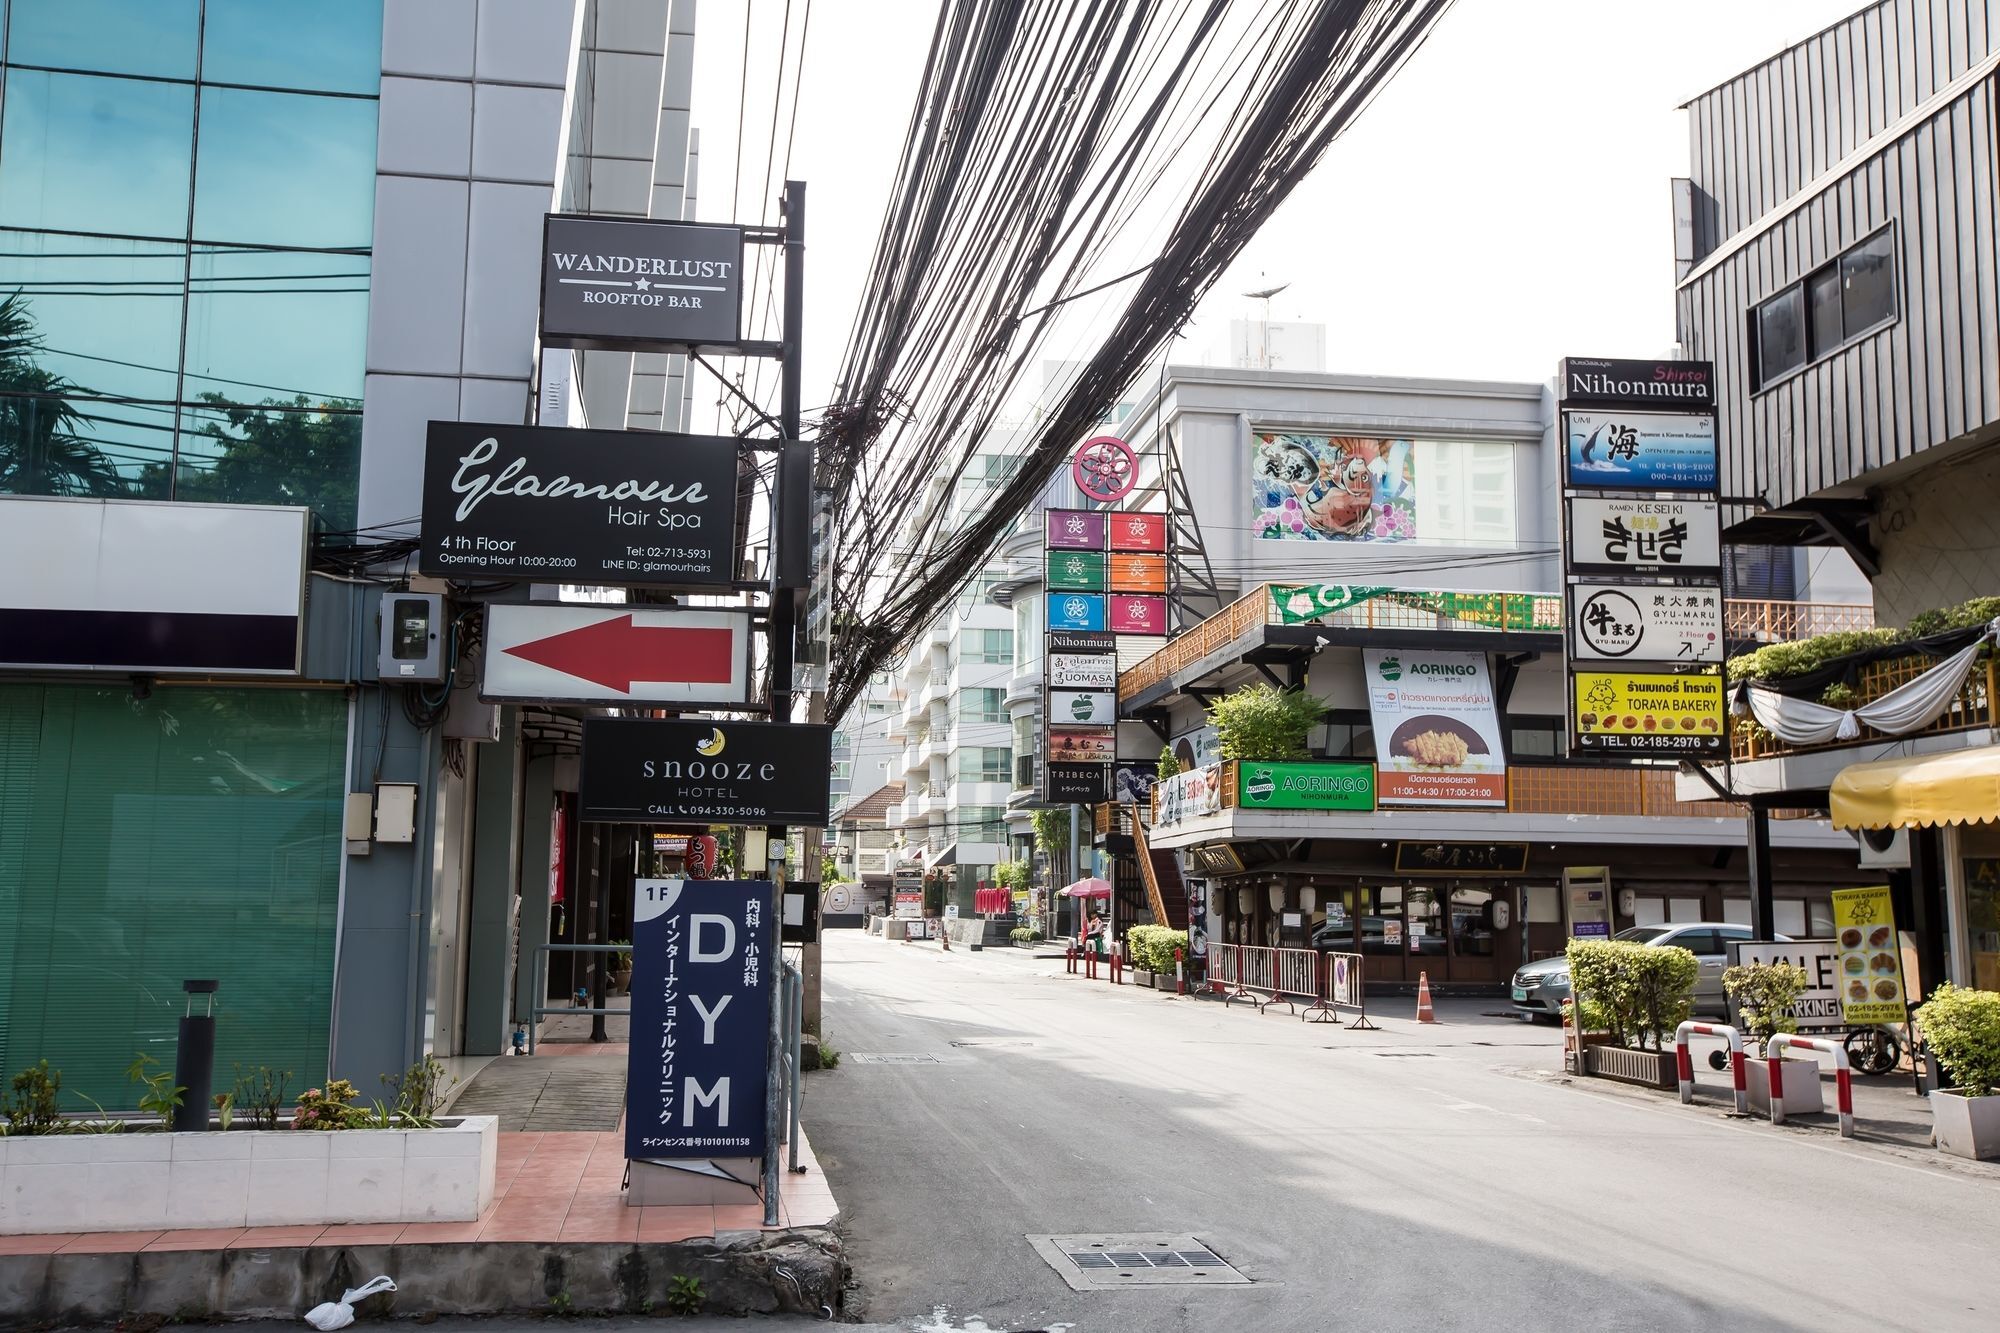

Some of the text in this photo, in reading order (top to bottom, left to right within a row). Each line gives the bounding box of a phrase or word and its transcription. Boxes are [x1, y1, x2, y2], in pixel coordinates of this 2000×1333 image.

[552, 252, 732, 279] WANDERLUST
[583, 290, 703, 309] ROOFTOP BAR
[1572, 373, 1709, 398] Nihonmura
[1573, 416, 1591, 425] UMI
[1607, 423, 1641, 462] 海
[450, 436, 708, 522] Glamour
[1608, 503, 1684, 515] RAMEN KE SEI KI
[608, 506, 701, 531] Hair Spa
[441, 535, 517, 552] 4 th Floor
[626, 545, 712, 560] Tel: 02-713-5931
[439, 553, 577, 568] Opening Hour 10:00-20:00
[602, 559, 711, 574] LINE ID: glamourhairs
[1586, 602, 1636, 637] 牛まる
[1653, 611, 1715, 619] GYU-MARU
[1053, 636, 1114, 648] Nihonmura
[1595, 638, 1630, 646] GYU-MARU
[1410, 663, 1477, 676] AORINGO
[1065, 674, 1113, 683] UOMASA
[1627, 698, 1718, 712] TORAYA BAKERY
[1600, 735, 1701, 748] TEL. 02-185-2976
[642, 757, 776, 783] snooze
[1051, 770, 1101, 779] TRIBECA
[1246, 783, 1275, 793] AORINGO
[1281, 775, 1369, 793] AORINGO
[678, 786, 739, 799] HOTEL
[1301, 793, 1350, 801] NIHONMURA
[1392, 786, 1439, 796] 11:00-14:30
[1446, 788, 1492, 797] 17:00-21:00
[648, 804, 767, 817] CALL 094-330-5096
[646, 887, 669, 902] 1F
[1835, 893, 1861, 902] TORAYA
[743, 898, 761, 987] 内科・小児科
[658, 914, 681, 1126] インターナショナルクリニック
